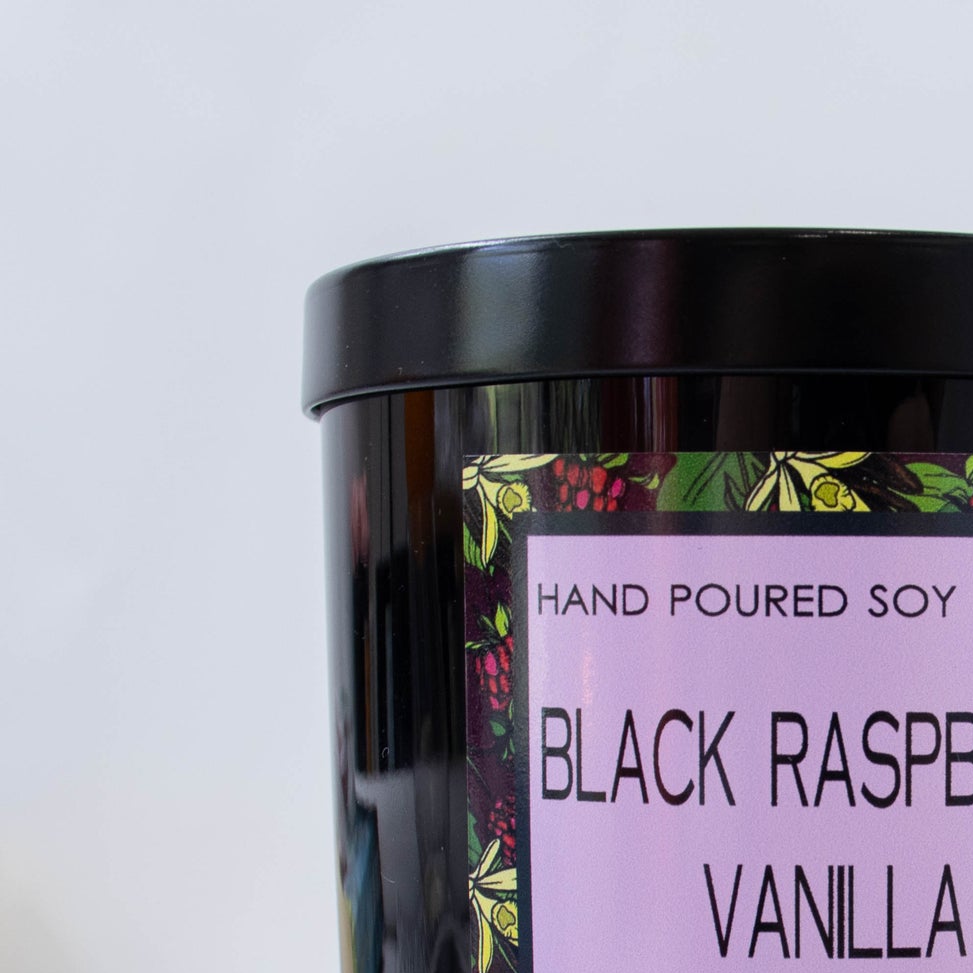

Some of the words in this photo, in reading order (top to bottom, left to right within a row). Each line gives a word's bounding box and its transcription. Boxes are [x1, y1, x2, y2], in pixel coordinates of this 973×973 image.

[538, 583, 649, 616] HAND
[670, 582, 849, 618] POURED
[867, 583, 957, 618] SOY
[541, 707, 737, 807] BLACK
[703, 863, 967, 960] VANILLA
